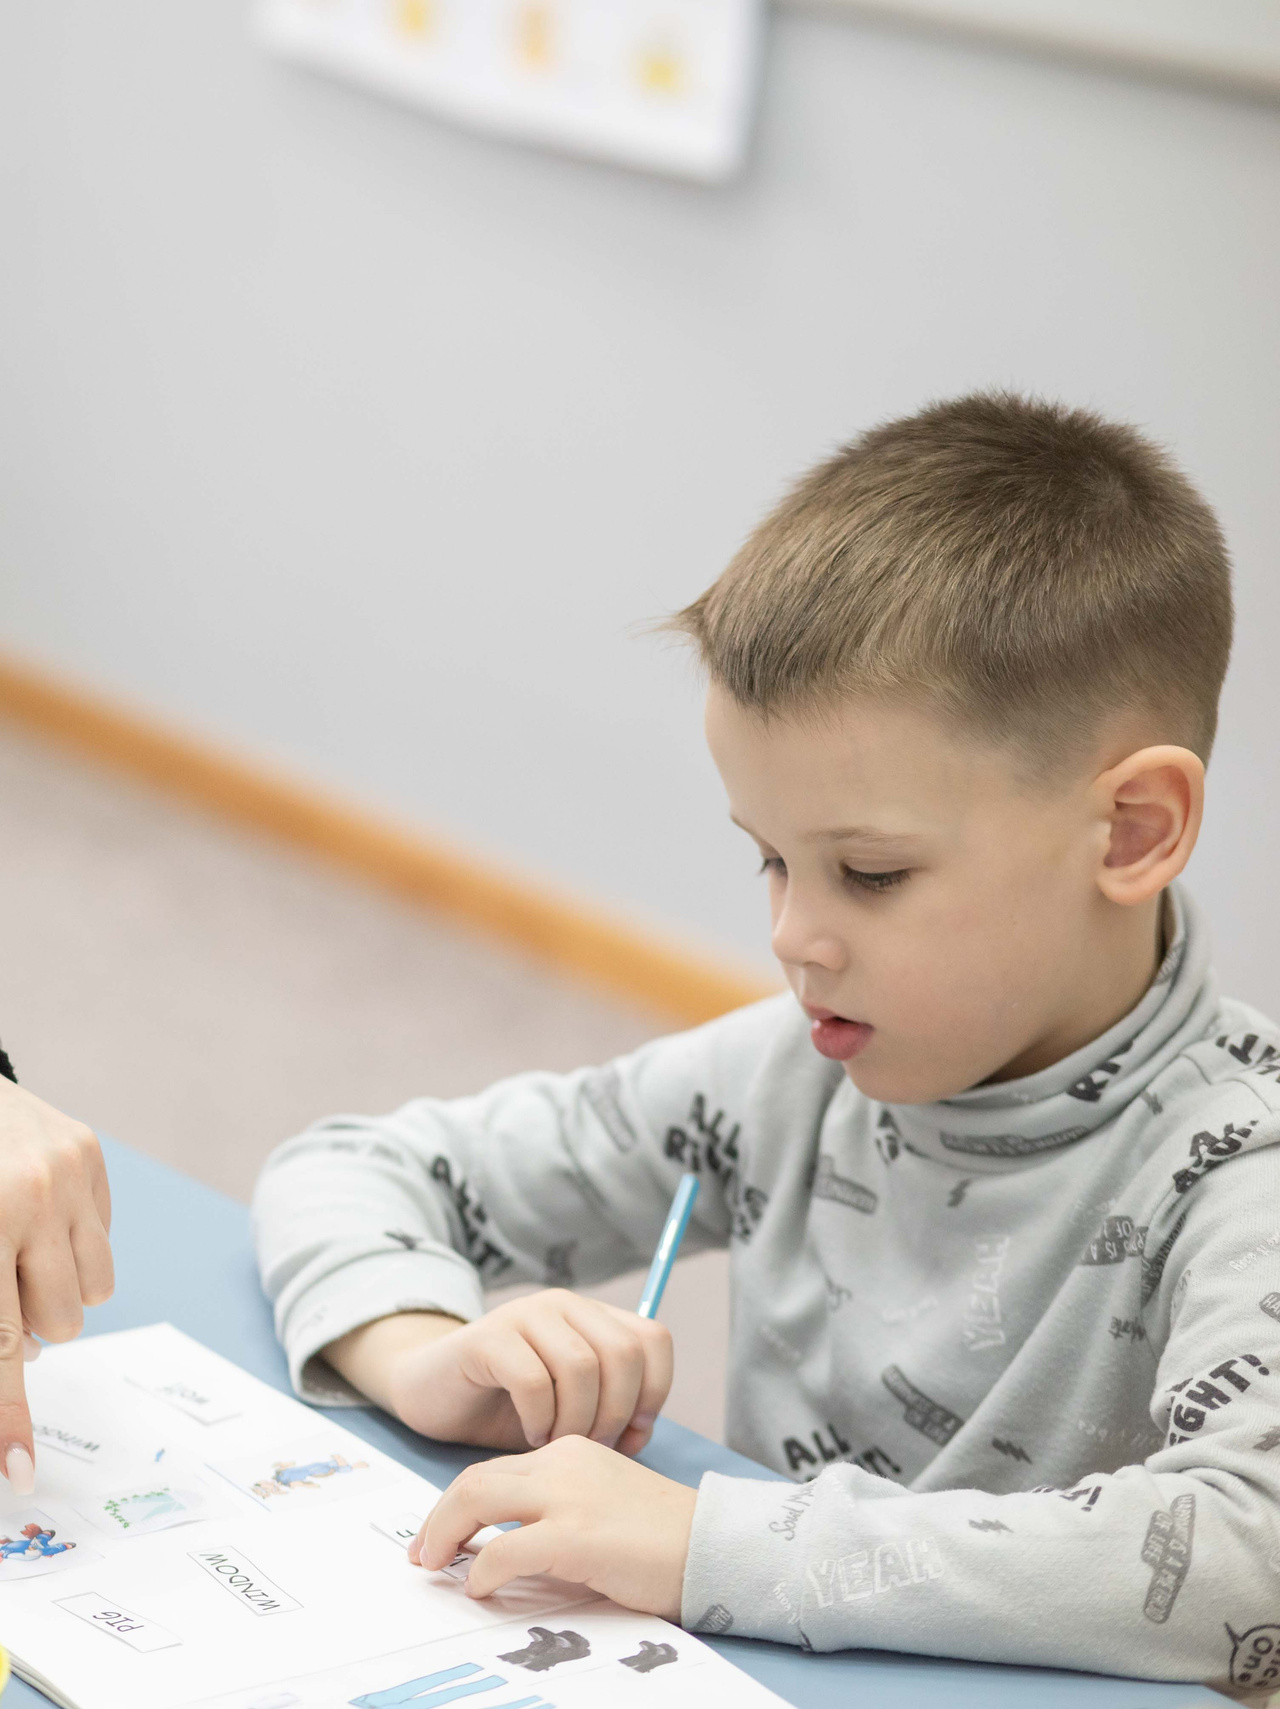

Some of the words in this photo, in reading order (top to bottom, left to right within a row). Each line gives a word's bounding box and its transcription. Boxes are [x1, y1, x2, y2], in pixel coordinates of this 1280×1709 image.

[782, 1422, 850, 1472] ALL
[200, 1551, 281, 1613] WINDOW
[805, 1534, 946, 1609] YEAH
[92, 1609, 145, 1634] PIG
